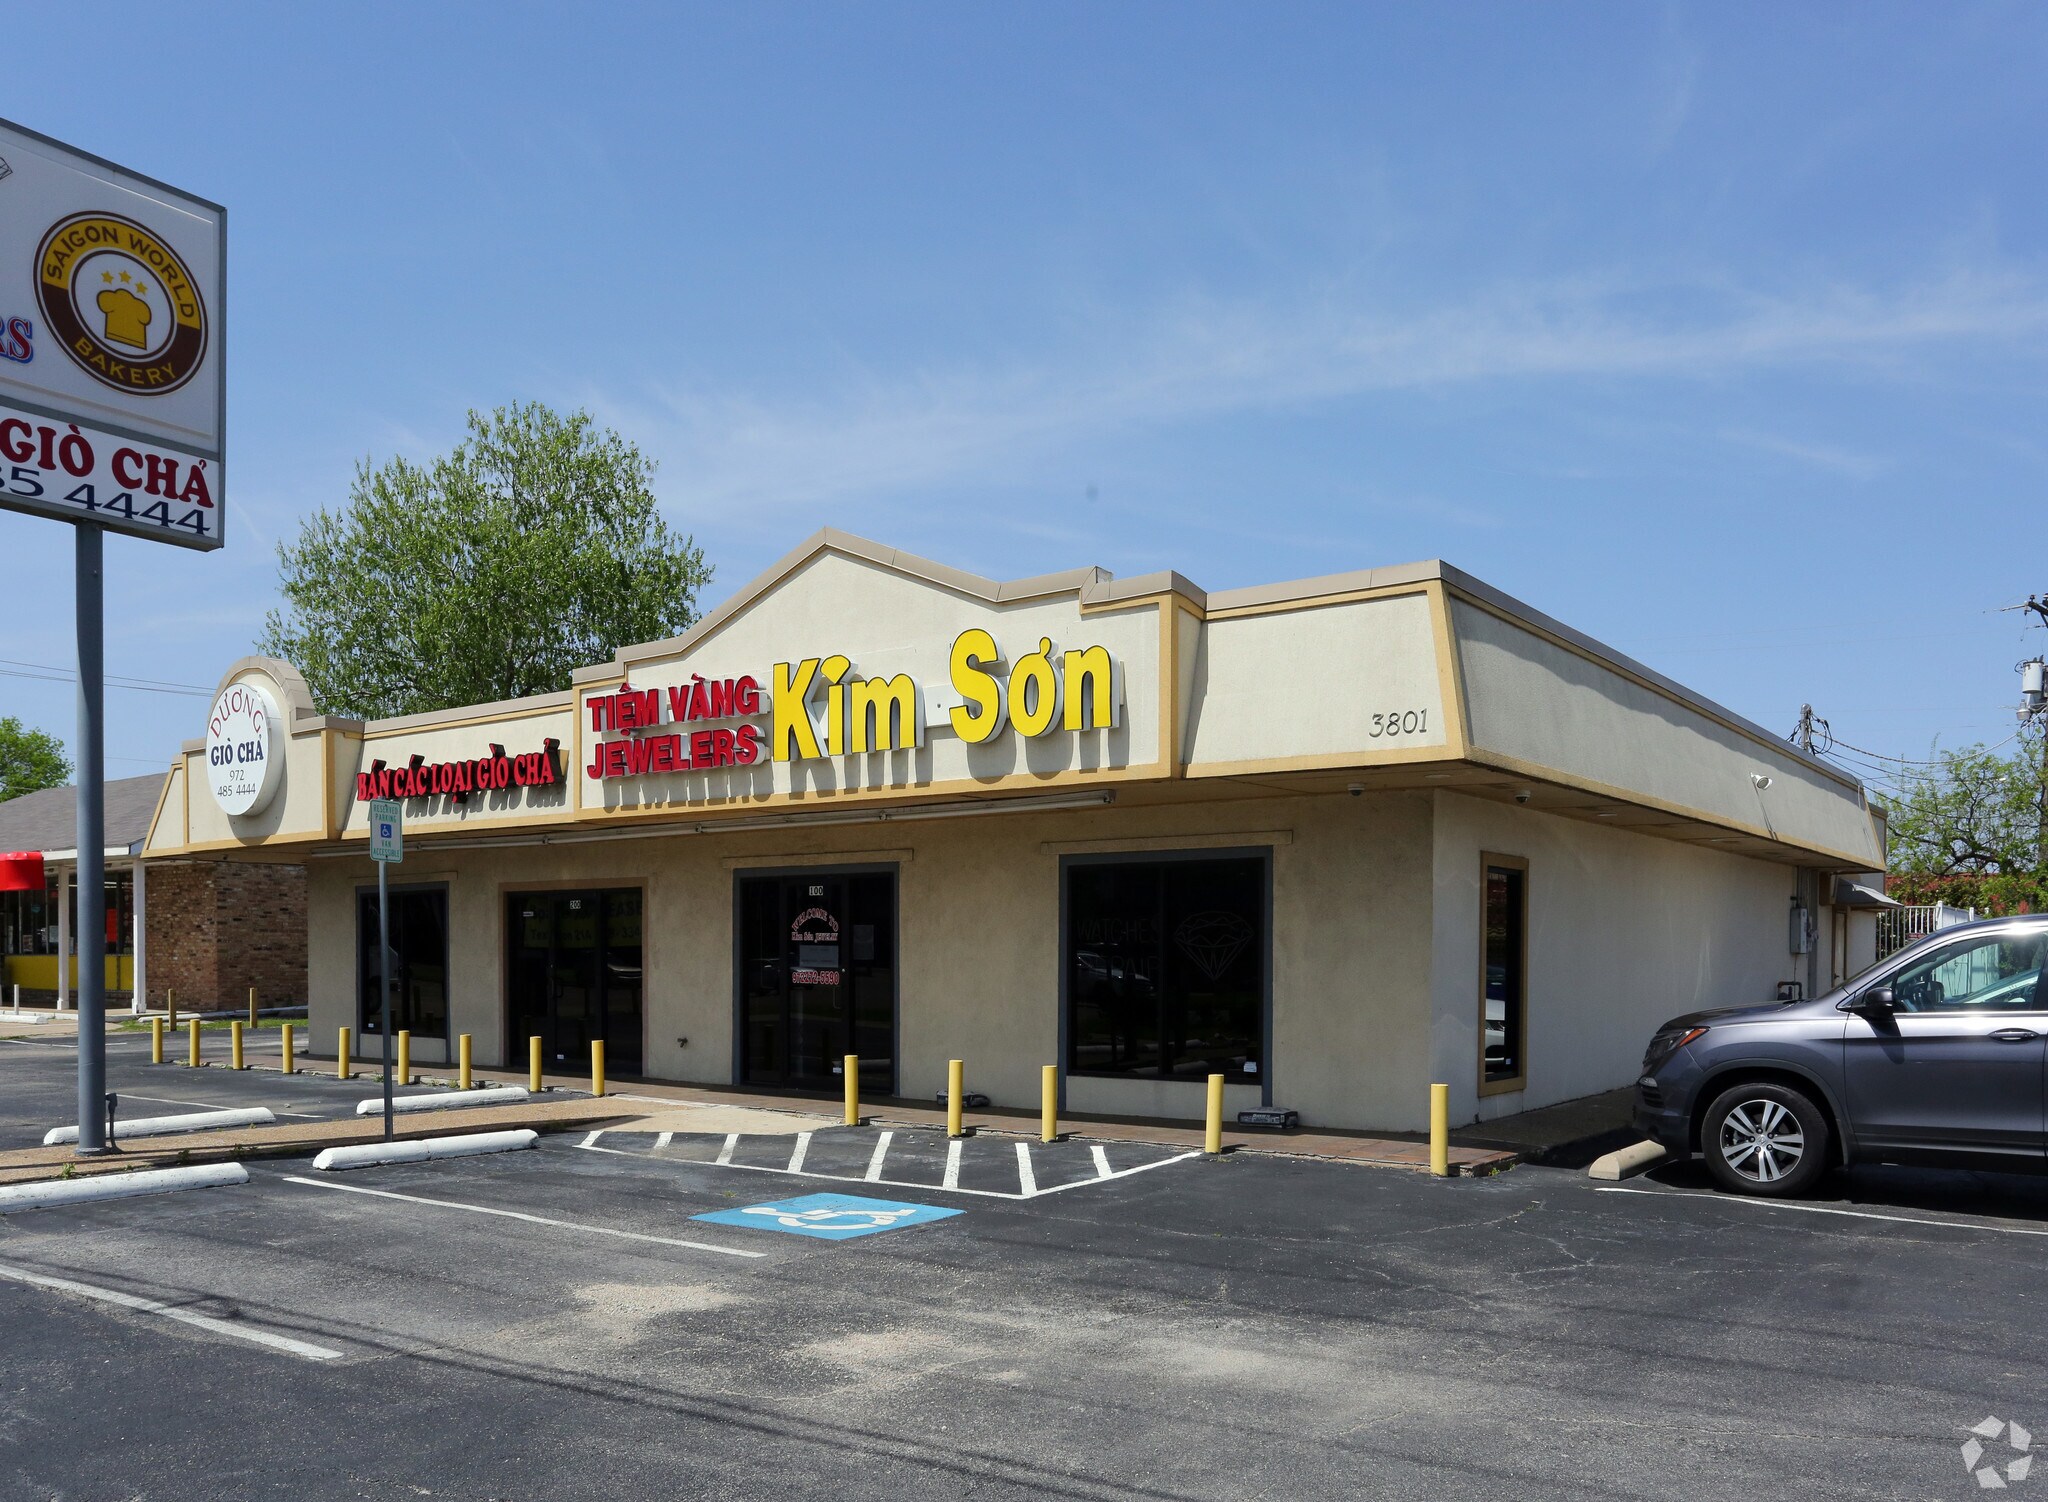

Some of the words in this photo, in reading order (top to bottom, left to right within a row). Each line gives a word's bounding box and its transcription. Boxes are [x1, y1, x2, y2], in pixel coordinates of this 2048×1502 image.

[47, 222, 119, 281] SAIGON
[129, 231, 197, 319] WORLD
[0, 314, 34, 364] S
[74, 336, 177, 385] BAKERY
[0, 418, 95, 478] GIÒ
[111, 447, 215, 509] CHẢ
[64, 483, 211, 536] 4444
[210, 688, 264, 739] DƯƠNG
[668, 672, 761, 723] VÀNG
[773, 654, 916, 762] Kim
[948, 628, 1113, 744] Sơn
[1368, 707, 1428, 738] 3801
[211, 737, 234, 766] GIÒ
[237, 734, 264, 764] CHẢ
[357, 758, 392, 801] BÁN
[393, 753, 428, 797] CÁC
[431, 759, 473, 804] LOẠI
[476, 742, 510, 789] GIÒ
[513, 737, 555, 786] CHẢ
[586, 723, 760, 780] JEWELERS
[217, 785, 233, 797] 485
[235, 782, 256, 796] 4444
[229, 769, 245, 782] 972
[373, 804, 398, 815] RESERVED
[375, 812, 397, 823] PARKING
[373, 847, 400, 858] ACCESSIBLE
[809, 886, 823, 895] 100
[791, 907, 828, 931] WELCOME
[828, 914, 839, 932] TO
